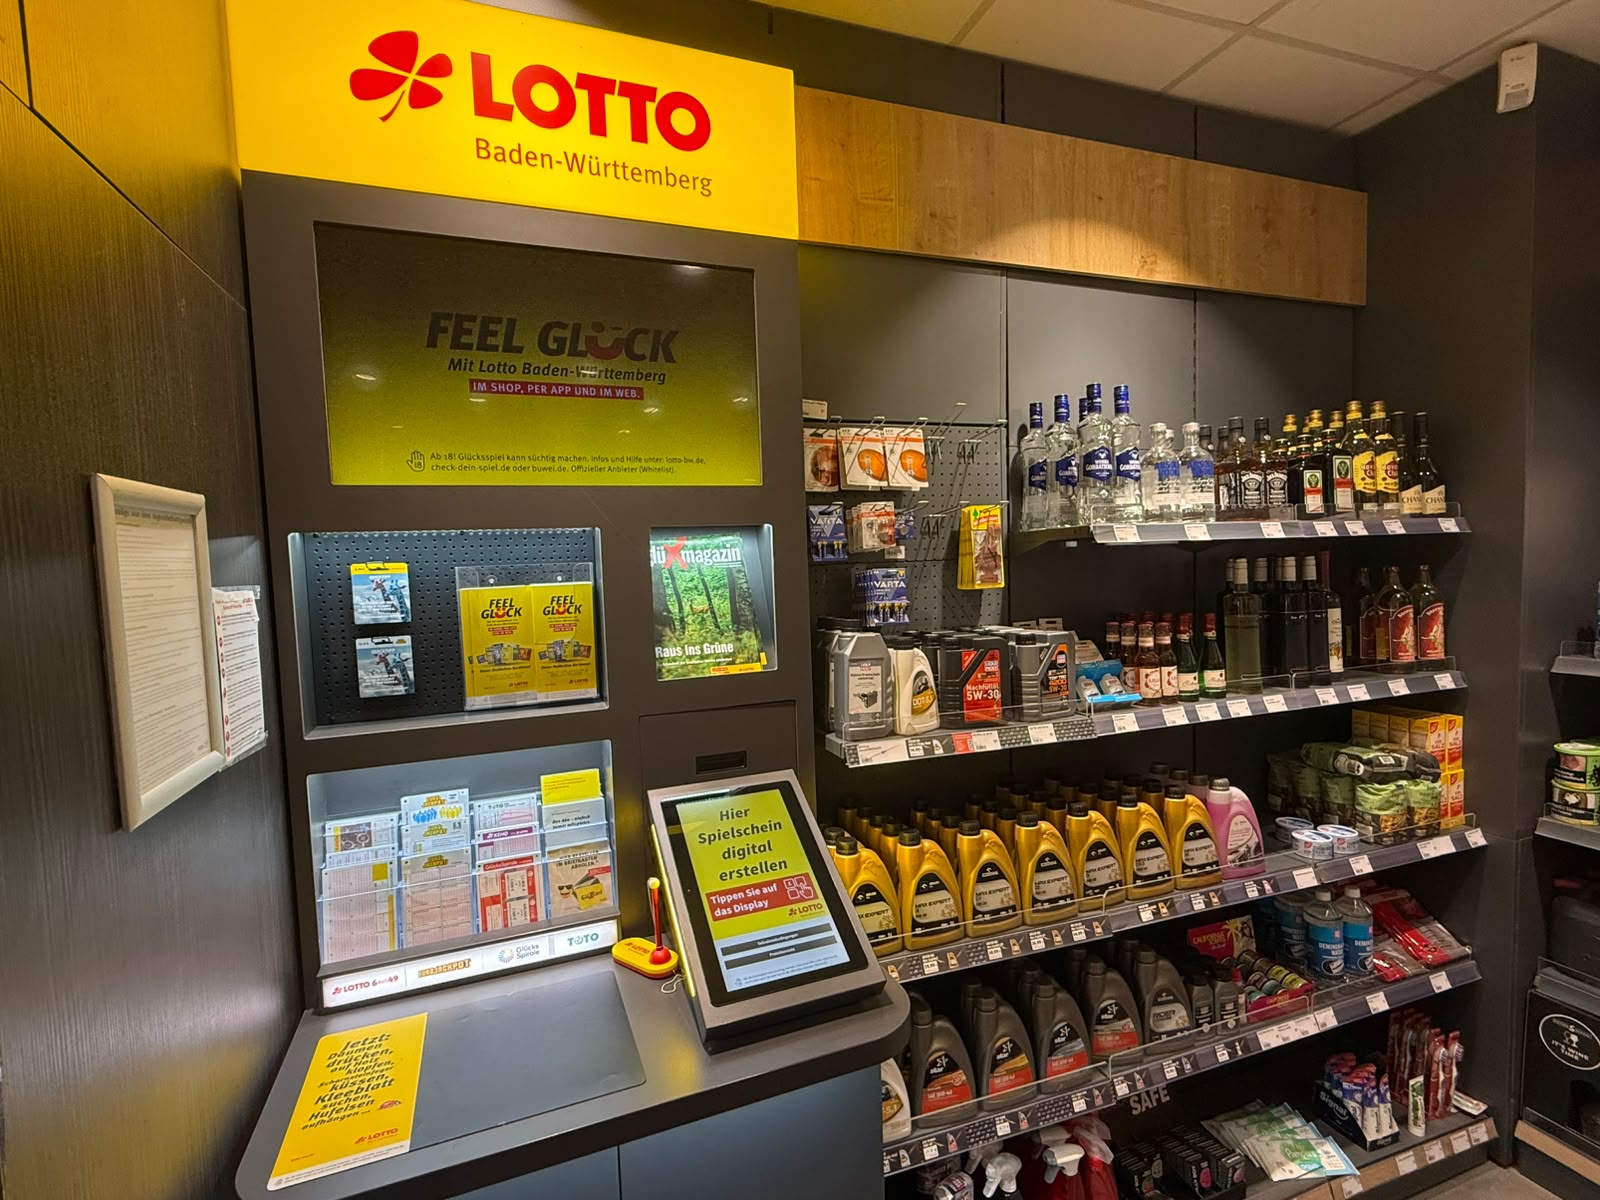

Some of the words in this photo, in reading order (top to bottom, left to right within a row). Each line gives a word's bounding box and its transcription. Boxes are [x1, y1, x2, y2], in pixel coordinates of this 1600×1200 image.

[470, 50, 711, 152] LOTTO
[474, 137, 713, 197] Baden-Württemberg
[426, 311, 524, 354] FEEL
[538, 320, 679, 363] GLÜCK
[448, 358, 474, 372] Mit
[478, 360, 517, 375] Lotto
[522, 362, 666, 385] Baden-Württemberg
[473, 382, 487, 391] IM
[491, 383, 524, 394] SHOP,
[528, 385, 547, 394] PER
[551, 385, 572, 395] APP
[574, 387, 597, 396] UND
[600, 387, 612, 397] IM
[615, 388, 640, 398] WEB.
[430, 452, 442, 460] Ab
[458, 452, 504, 462] Glücksspiel
[507, 453, 526, 461] kann
[528, 454, 556, 463] süchtig
[571, 464, 605, 472] Offizieller
[607, 465, 637, 473] Anbieter
[811, 517, 843, 525] VARTA
[874, 580, 906, 588] VARTA
[489, 598, 515, 609] FEEL
[550, 595, 575, 605] FEEL
[481, 607, 523, 619] GLÜCK
[543, 604, 582, 616] GLÜCK
[655, 645, 683, 658] Raus
[703, 642, 734, 655] Grüne
[967, 690, 1000, 700] 5W-30
[719, 807, 750, 821] Hier
[698, 820, 782, 845] Spielschein
[722, 840, 773, 860] digital
[719, 859, 788, 882] erstellen
[710, 889, 745, 905] Tippen
[745, 887, 761, 897] Sie
[763, 883, 778, 894] auf
[714, 907, 732, 917] das
[733, 899, 769, 914] Display
[799, 902, 823, 914] LOTTO
[865, 909, 889, 918] EXPERT
[568, 932, 599, 946] TOTO
[516, 944, 540, 953] Glücks
[343, 981, 370, 993] LOTTO
[340, 1034, 391, 1052] Jetzt:
[326, 1049, 393, 1068] drücken,
[327, 1043, 382, 1060] Daumen
[330, 1063, 352, 1072] auf
[353, 1057, 380, 1067] Holz
[314, 1079, 395, 1105] Kleeblatt
[1130, 1085, 1170, 1115] SAFE
[308, 1099, 375, 1121] Hufeisen
[1320, 1091, 1347, 1116] Signal
[301, 1111, 359, 1130] aufhängen
[368, 1128, 399, 1140] LOTTO
